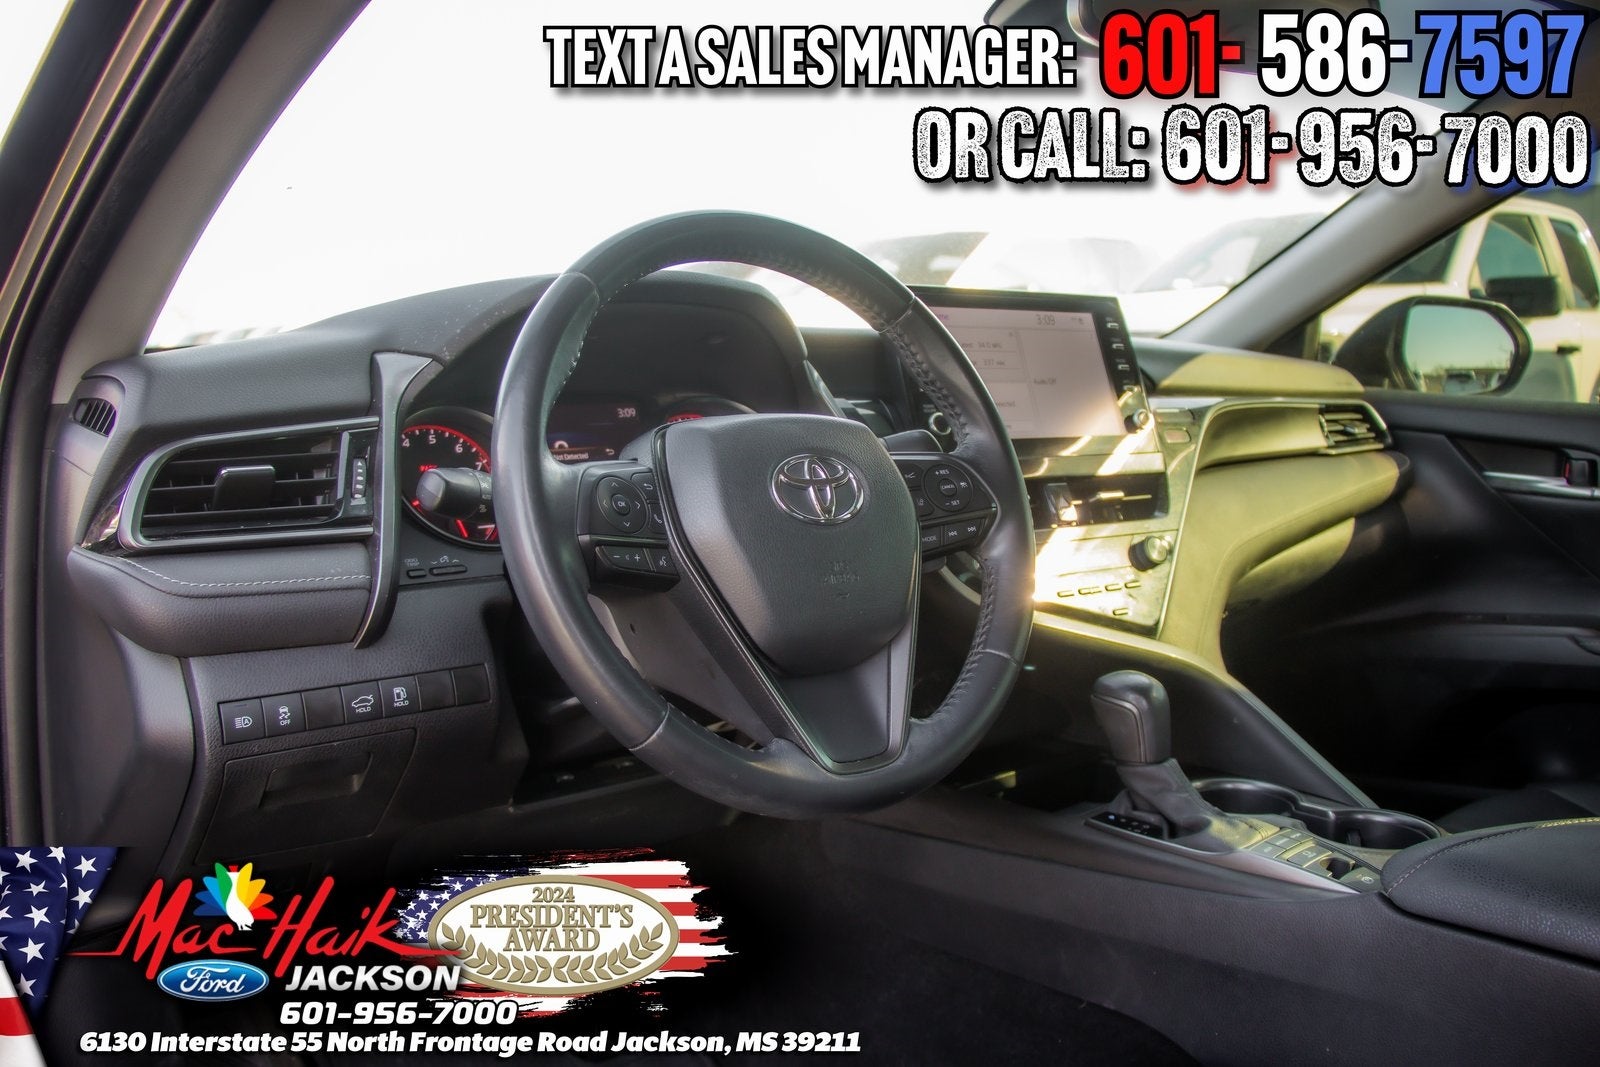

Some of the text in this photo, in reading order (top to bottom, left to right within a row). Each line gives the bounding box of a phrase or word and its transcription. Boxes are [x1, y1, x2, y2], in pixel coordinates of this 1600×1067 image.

[1036, 313, 1056, 326] 3:09
[617, 407, 636, 418] 3:09
[402, 438, 410, 448] 4
[428, 435, 436, 444] 5
[455, 443, 463, 453] 6
[356, 706, 371, 714] HOLD
[280, 718, 291, 726] OFF
